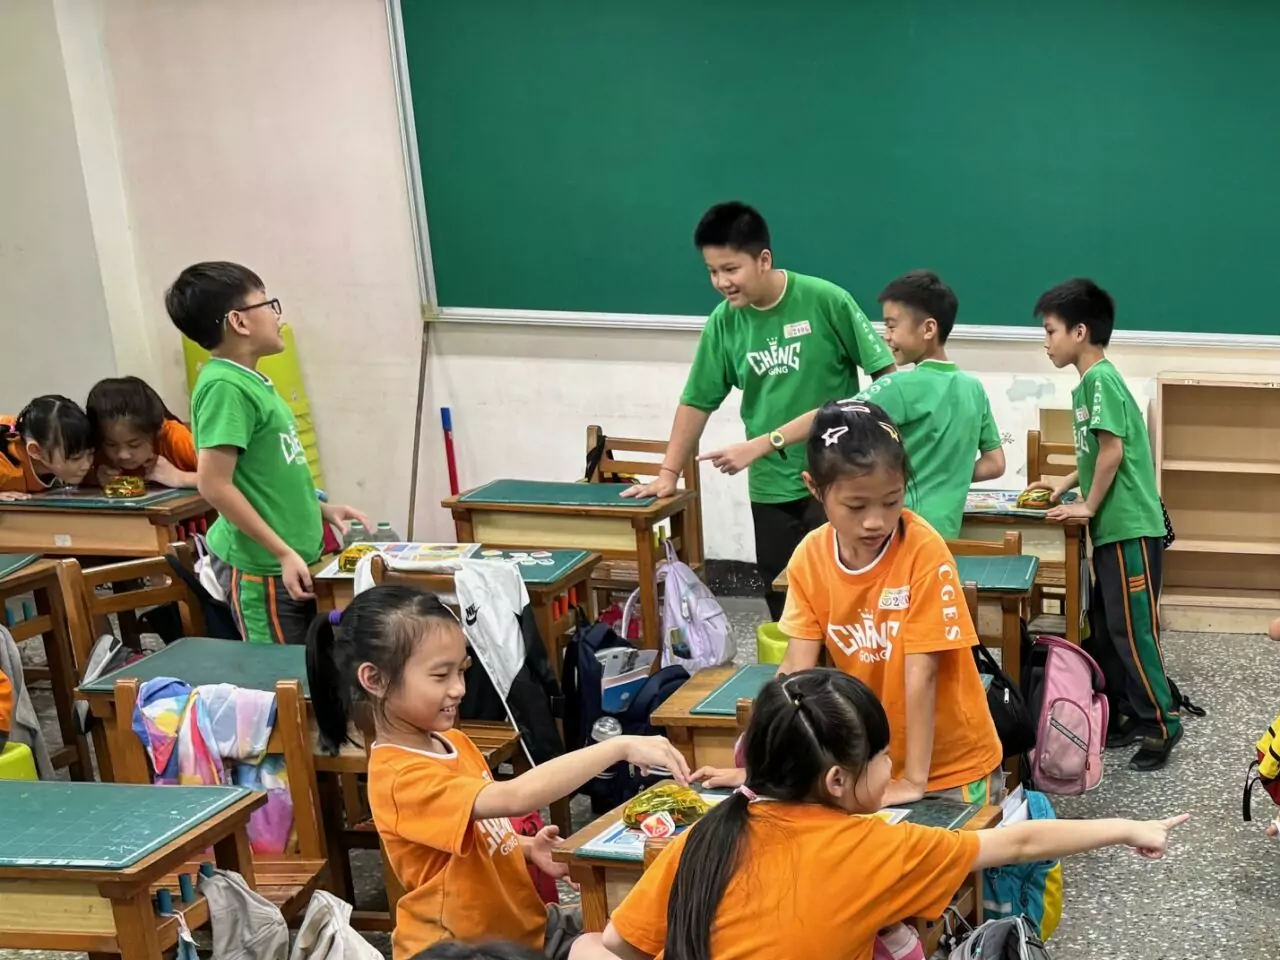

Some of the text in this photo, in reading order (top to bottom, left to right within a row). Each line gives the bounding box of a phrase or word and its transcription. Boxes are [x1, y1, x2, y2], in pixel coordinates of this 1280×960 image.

[746, 342, 801, 376] CHENG
[767, 365, 789, 376] GONG
[938, 563, 962, 641] CGES
